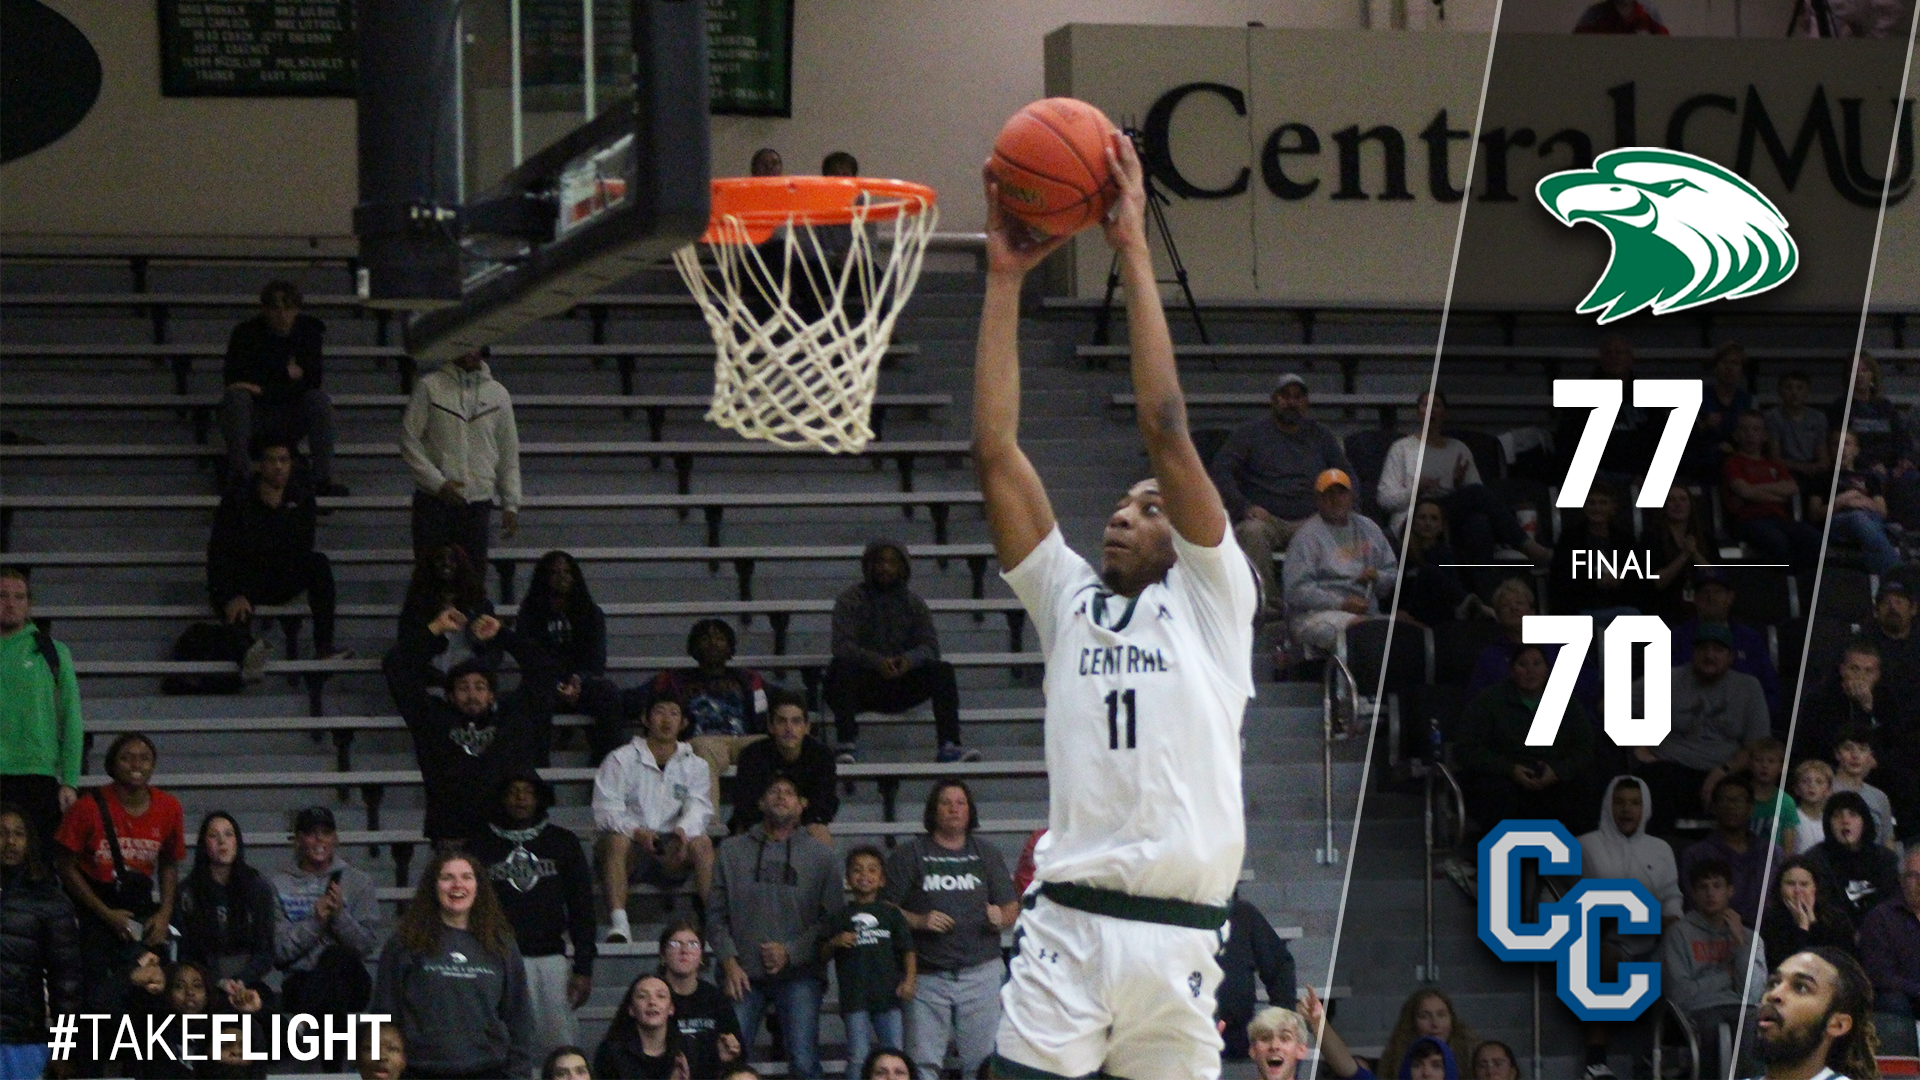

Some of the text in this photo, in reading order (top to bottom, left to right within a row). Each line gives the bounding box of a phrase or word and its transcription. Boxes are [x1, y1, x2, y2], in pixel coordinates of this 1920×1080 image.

[1080, 645, 1167, 675] CENTRAL
[1105, 689, 1136, 749] 11
[922, 873, 977, 893] MOM
